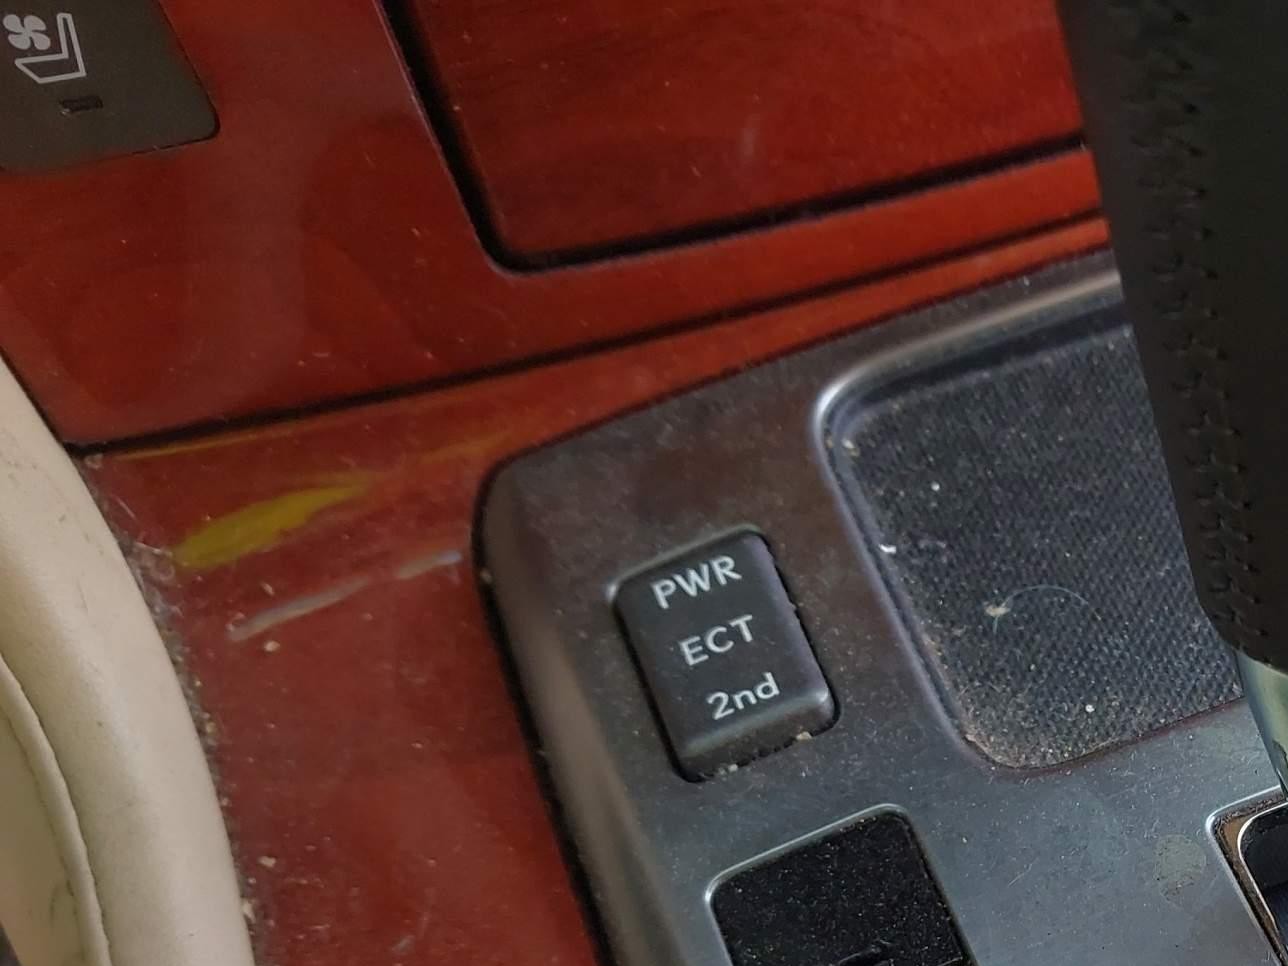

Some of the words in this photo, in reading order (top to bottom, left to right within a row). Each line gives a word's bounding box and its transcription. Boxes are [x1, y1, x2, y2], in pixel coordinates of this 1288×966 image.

[652, 556, 742, 609] PWR
[678, 615, 754, 666] ECT
[707, 672, 780, 720] 2nd
